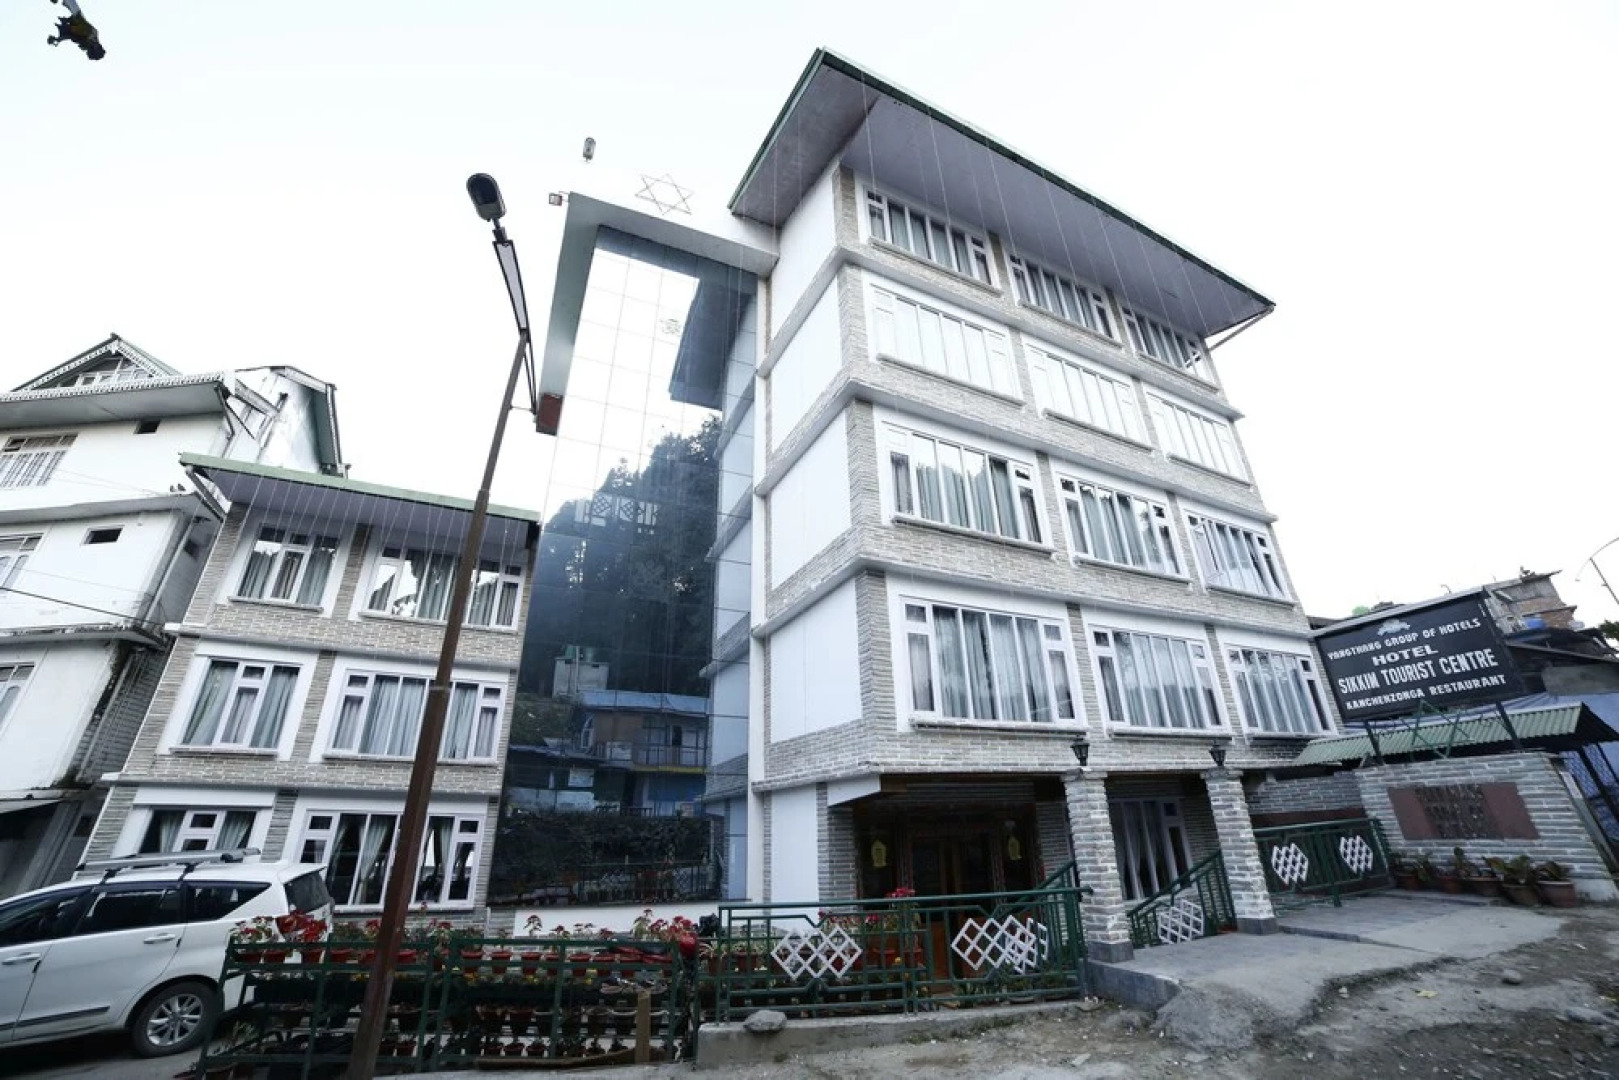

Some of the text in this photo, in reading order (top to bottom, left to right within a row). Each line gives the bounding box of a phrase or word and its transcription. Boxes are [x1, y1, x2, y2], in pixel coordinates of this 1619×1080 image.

[1384, 632, 1418, 647] GROUP
[1422, 627, 1436, 638] OF
[1439, 618, 1481, 635] HOTELS
[1372, 644, 1439, 666] HOTEL
[1338, 648, 1499, 694] SIKKIM TOURIST CENTRE
[1428, 674, 1506, 696] RESTAURANT
